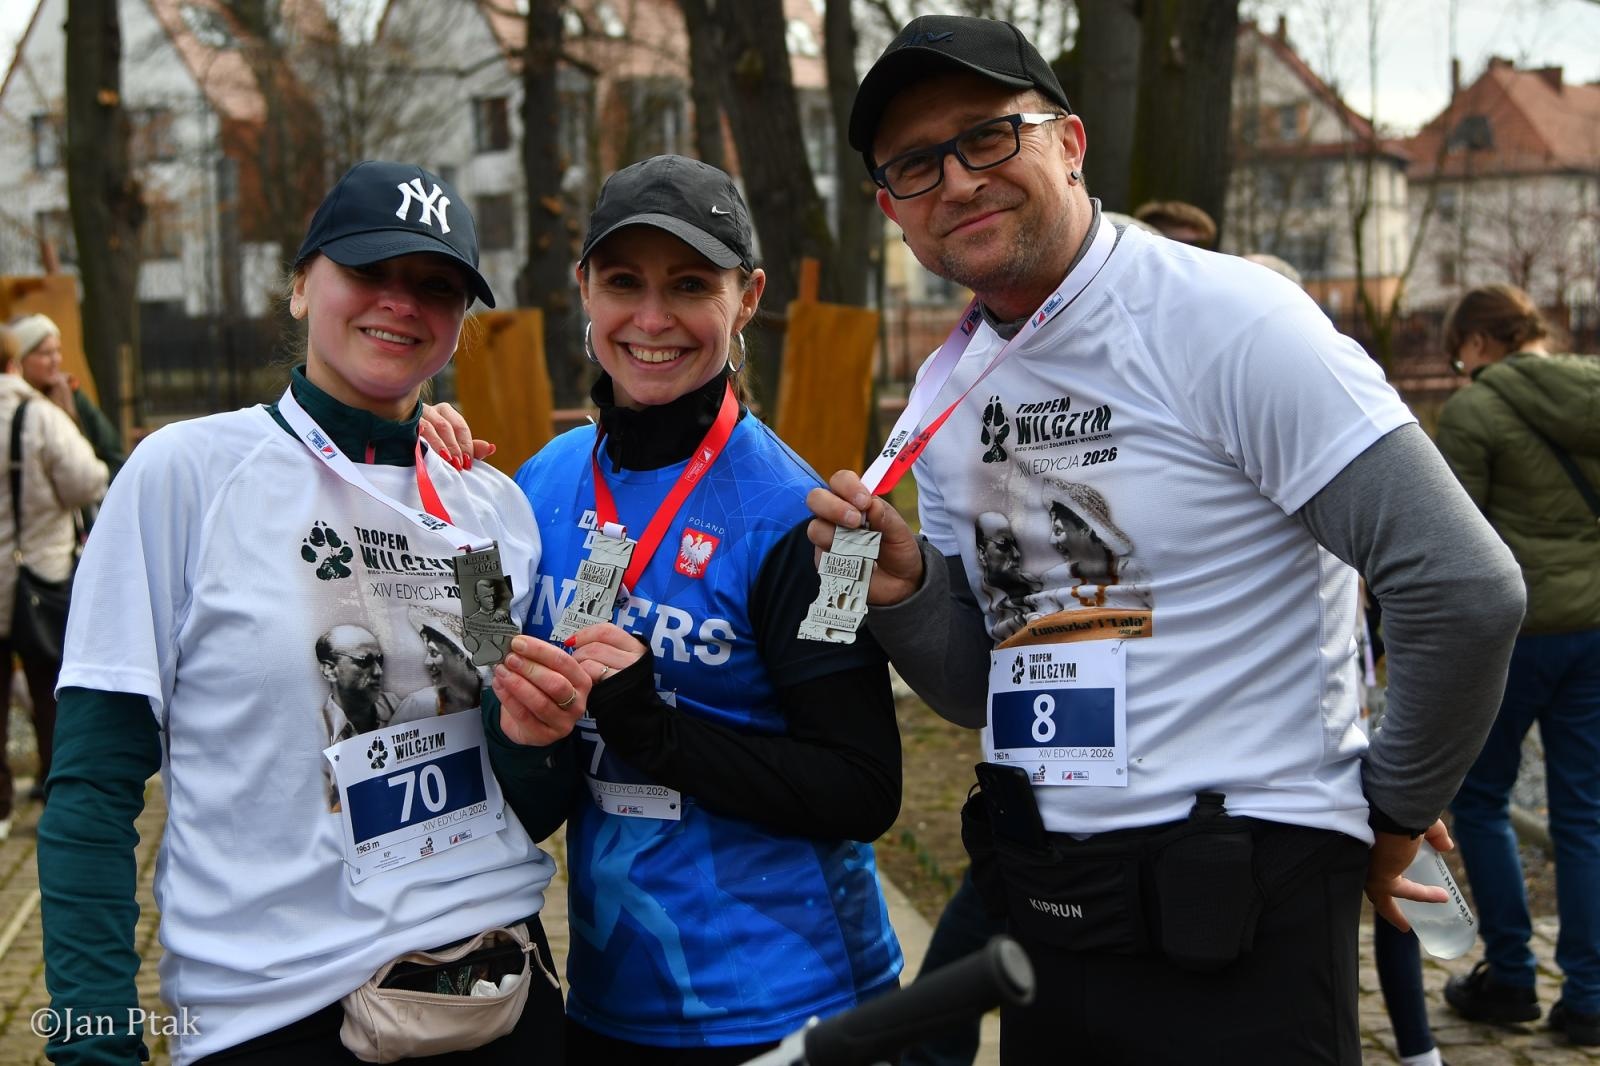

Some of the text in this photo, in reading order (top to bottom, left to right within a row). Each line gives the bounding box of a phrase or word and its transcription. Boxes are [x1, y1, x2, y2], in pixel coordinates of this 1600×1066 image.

[395, 177, 451, 235] NY
[1016, 396, 1071, 414] TROPEM
[1015, 404, 1112, 445] WILCZYM
[1033, 454, 1080, 475] EDYCJA
[1081, 446, 1118, 467] 2026
[688, 516, 725, 535] POLAND
[354, 525, 409, 551] TROPEM
[370, 582, 392, 597] XIV
[395, 583, 445, 600] EDYCJA
[1029, 653, 1052, 663] TROPEM
[1029, 662, 1077, 680] WILCZYM
[1031, 693, 1056, 743] 8
[391, 728, 420, 744] TROPEM
[394, 732, 446, 761] WILCZYM
[1038, 748, 1114, 758] XIV EDYCJA 2026
[387, 764, 448, 823] 70
[610, 784, 645, 795] EDYCJA
[646, 787, 669, 797] 2026
[422, 802, 488, 832] XIV EDYCJA 2026
[356, 841, 380, 854] 1963 m
[1029, 898, 1083, 918] KIPRUN
